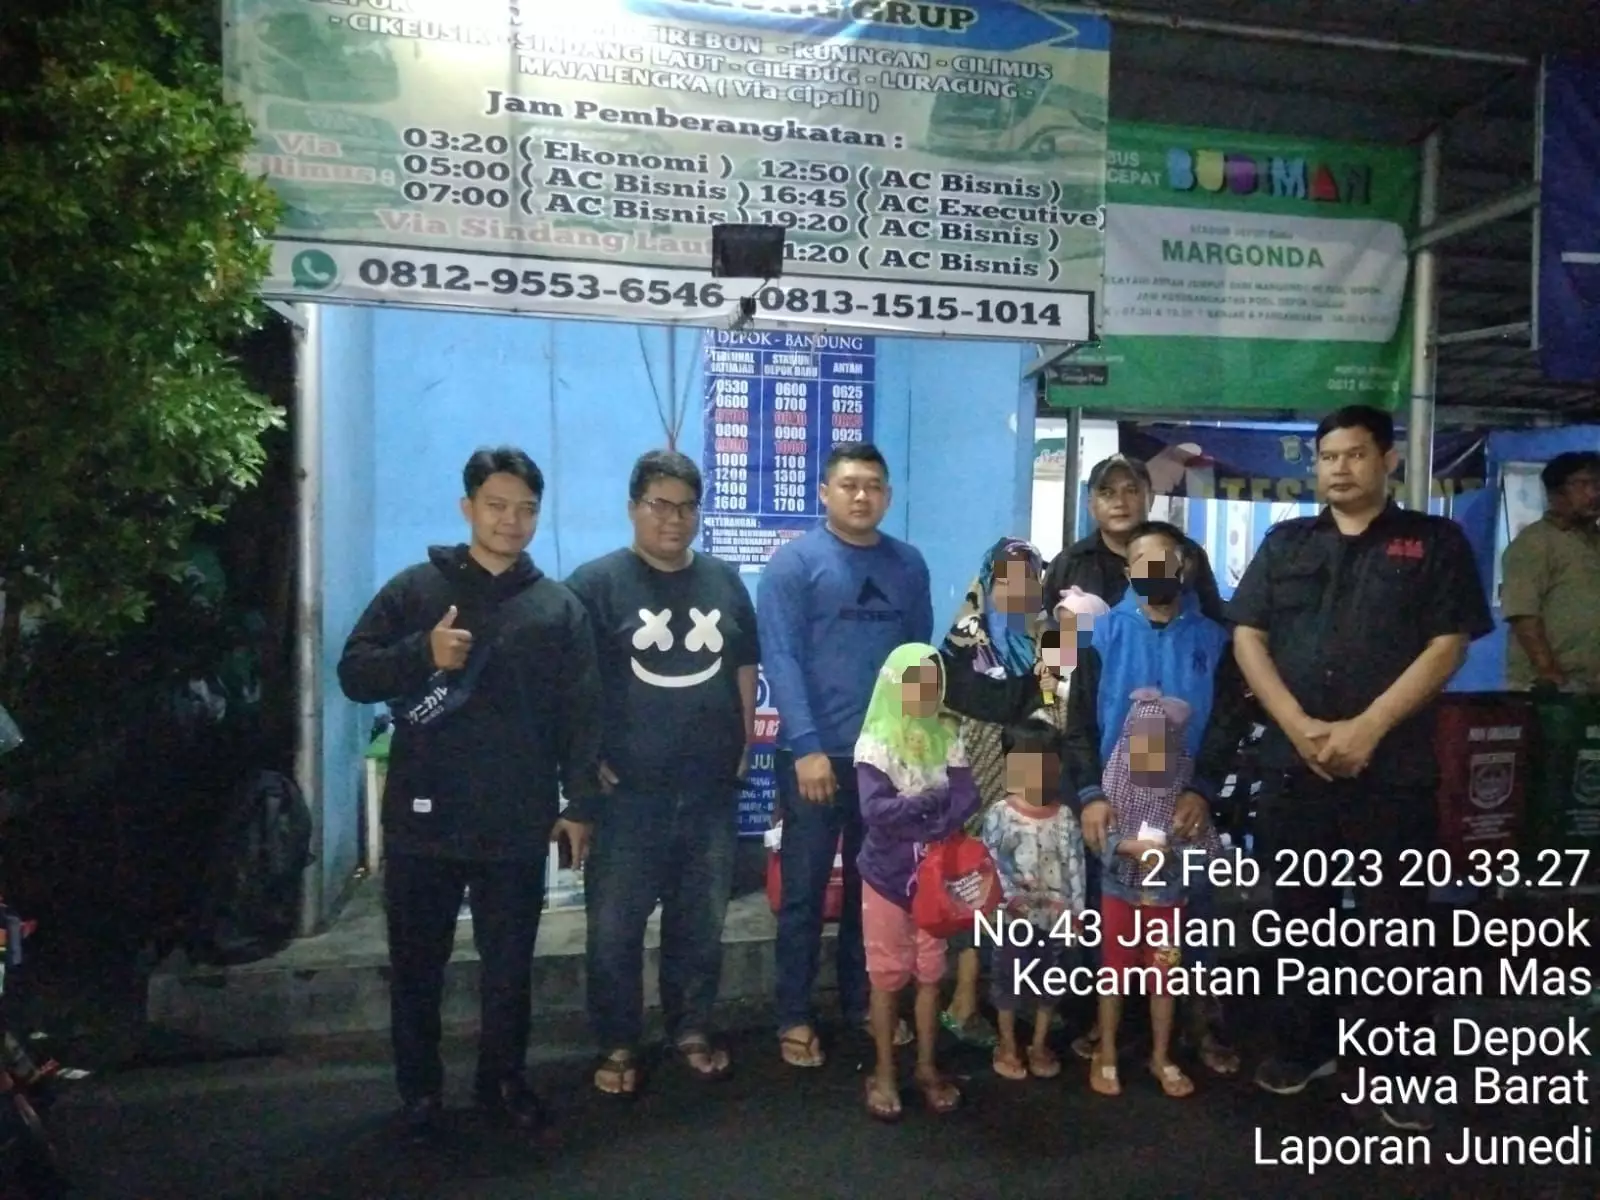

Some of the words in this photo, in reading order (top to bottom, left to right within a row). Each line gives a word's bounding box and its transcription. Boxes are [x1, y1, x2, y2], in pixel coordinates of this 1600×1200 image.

[852, 1, 977, 32] GRUP
[516, 32, 642, 63] SINDANG
[651, 46, 725, 73] LAUT
[746, 60, 859, 86] CILEDUG
[881, 73, 1020, 99] LURAGUNG
[793, 42, 930, 70] KUNINGAN
[951, 56, 1053, 81] CILIMUS
[518, 55, 710, 94] MAJALENGKA
[735, 80, 778, 101] Via
[486, 91, 563, 118] Jam
[575, 101, 886, 147] Pemberangkatan
[276, 131, 342, 157] Via
[403, 127, 508, 155] 03:20
[544, 140, 709, 173] Ekonomi
[761, 159, 849, 183] 12:50
[881, 170, 931, 190] AC
[941, 174, 1041, 199] Bisnis
[1106, 167, 1162, 185] CEPAT
[403, 154, 510, 181] 05:00
[545, 168, 602, 189] AC
[614, 173, 727, 200] Bisnis
[760, 185, 848, 209] 16:45
[878, 194, 930, 215] AC
[403, 180, 510, 208] 07:00
[545, 194, 602, 216] AC
[613, 199, 727, 224] Bisnis
[761, 210, 849, 234] 19:20
[879, 219, 931, 240] AC
[941, 223, 1040, 247] Bisnis
[377, 209, 449, 236] Via
[458, 215, 627, 254] Sindang
[880, 248, 930, 270] AC
[942, 253, 1040, 277] Bisnis
[1161, 239, 1324, 269] MARGONDA
[358, 258, 724, 308] 0812-9553-6546
[759, 286, 1062, 326] 0813-1515-1014
[718, 331, 773, 346] DEPOK
[785, 334, 863, 350] BANDUNG
[716, 379, 749, 394] 0530
[775, 382, 807, 397] 0600
[832, 385, 863, 399] 0625
[775, 397, 807, 411] 0700
[832, 400, 863, 414] 0725
[775, 426, 807, 440] 0900
[831, 428, 863, 442] 0925
[715, 453, 748, 467] 1000
[774, 455, 806, 469] 1100
[715, 468, 747, 481] 1200
[774, 470, 806, 483] 1300
[714, 482, 747, 496] 1400
[773, 484, 806, 498] 1500
[714, 496, 747, 510] 1600
[773, 498, 805, 512] 1700
